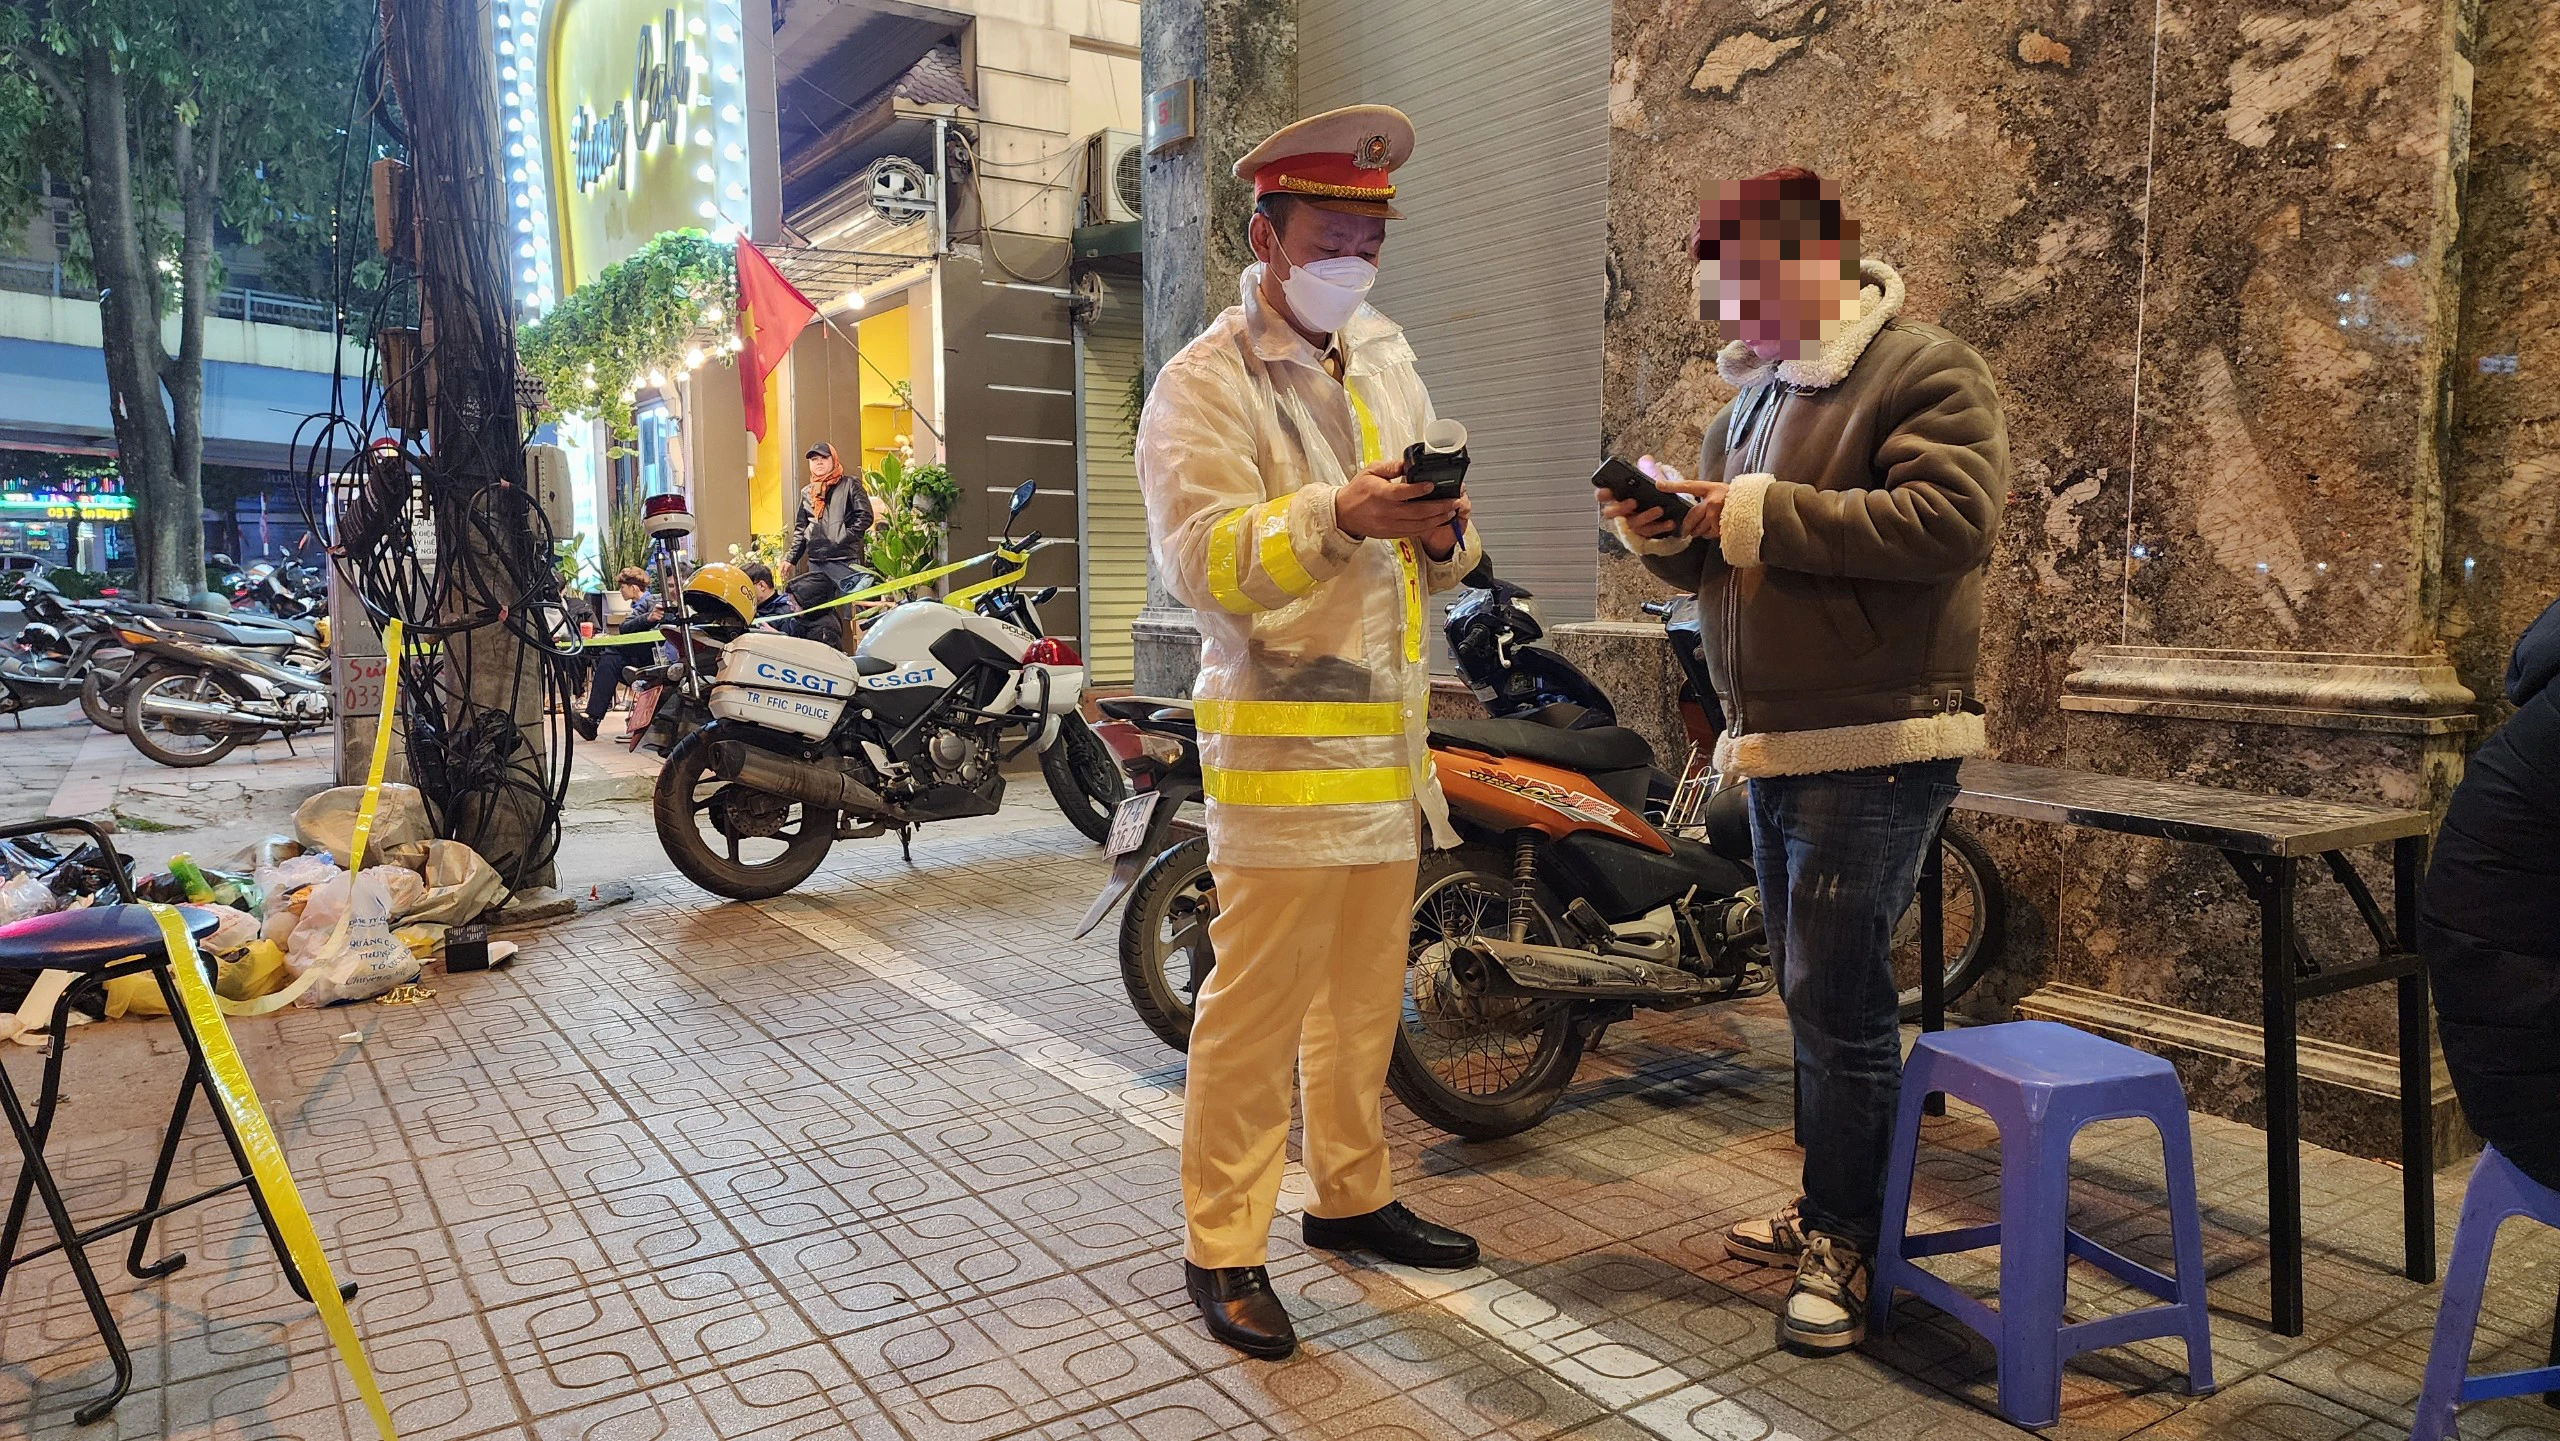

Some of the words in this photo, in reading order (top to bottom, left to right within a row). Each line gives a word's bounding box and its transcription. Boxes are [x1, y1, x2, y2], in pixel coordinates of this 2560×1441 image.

[1158, 101, 1169, 126] 5
[757, 663, 838, 696] C.S.G.T
[867, 667, 937, 688] C.S.G.T
[795, 703, 830, 720] POLICE
